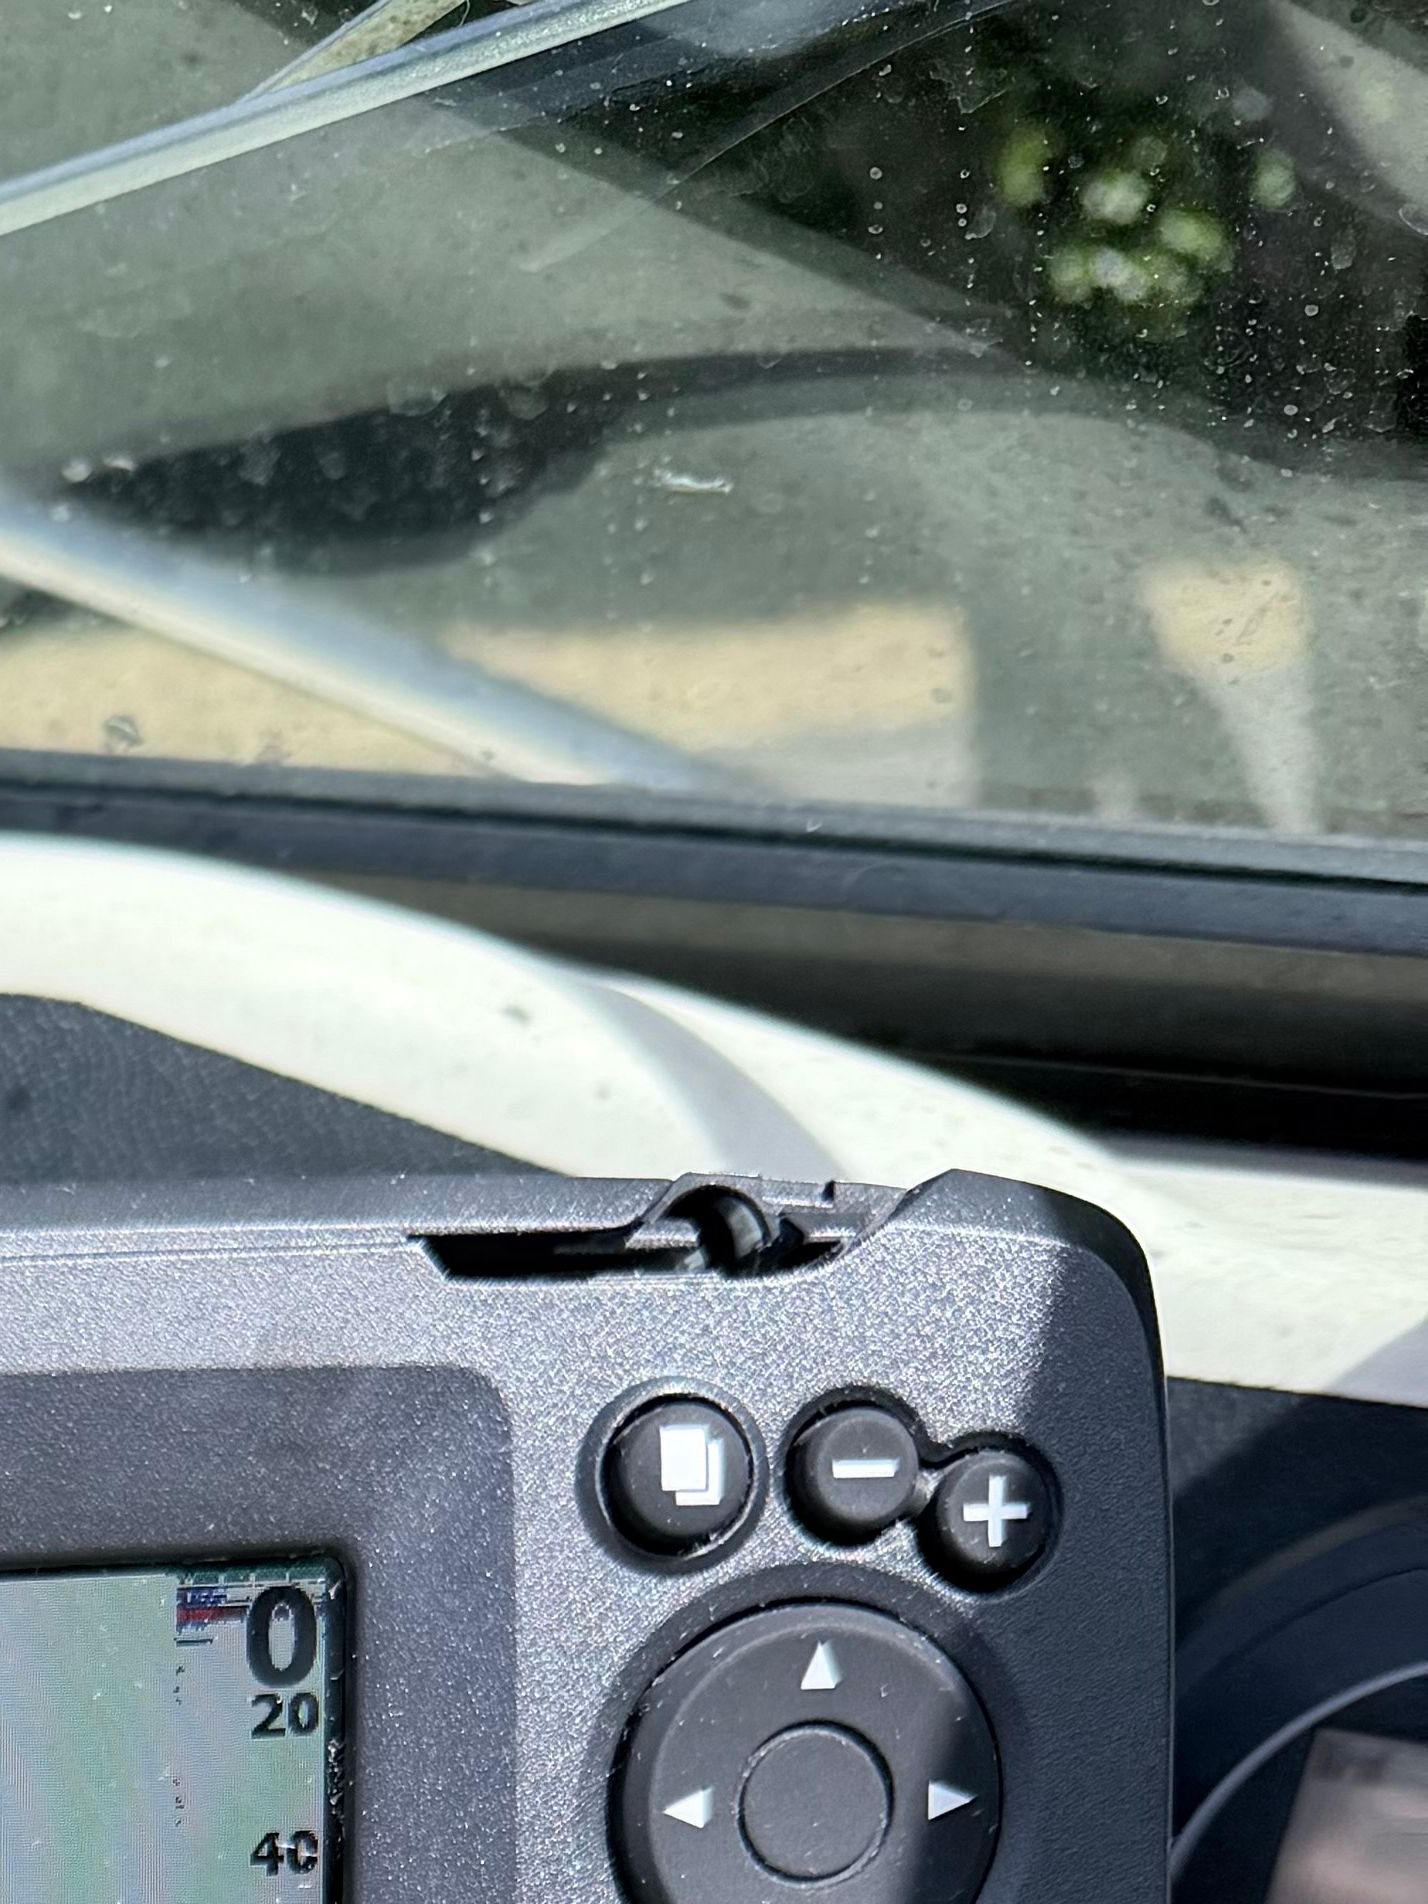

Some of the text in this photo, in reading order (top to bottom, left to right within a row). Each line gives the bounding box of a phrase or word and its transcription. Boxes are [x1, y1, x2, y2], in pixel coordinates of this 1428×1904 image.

[247, 1585, 318, 1687] 0
[250, 1692, 319, 1739] 20
[250, 1829, 319, 1876] 40
